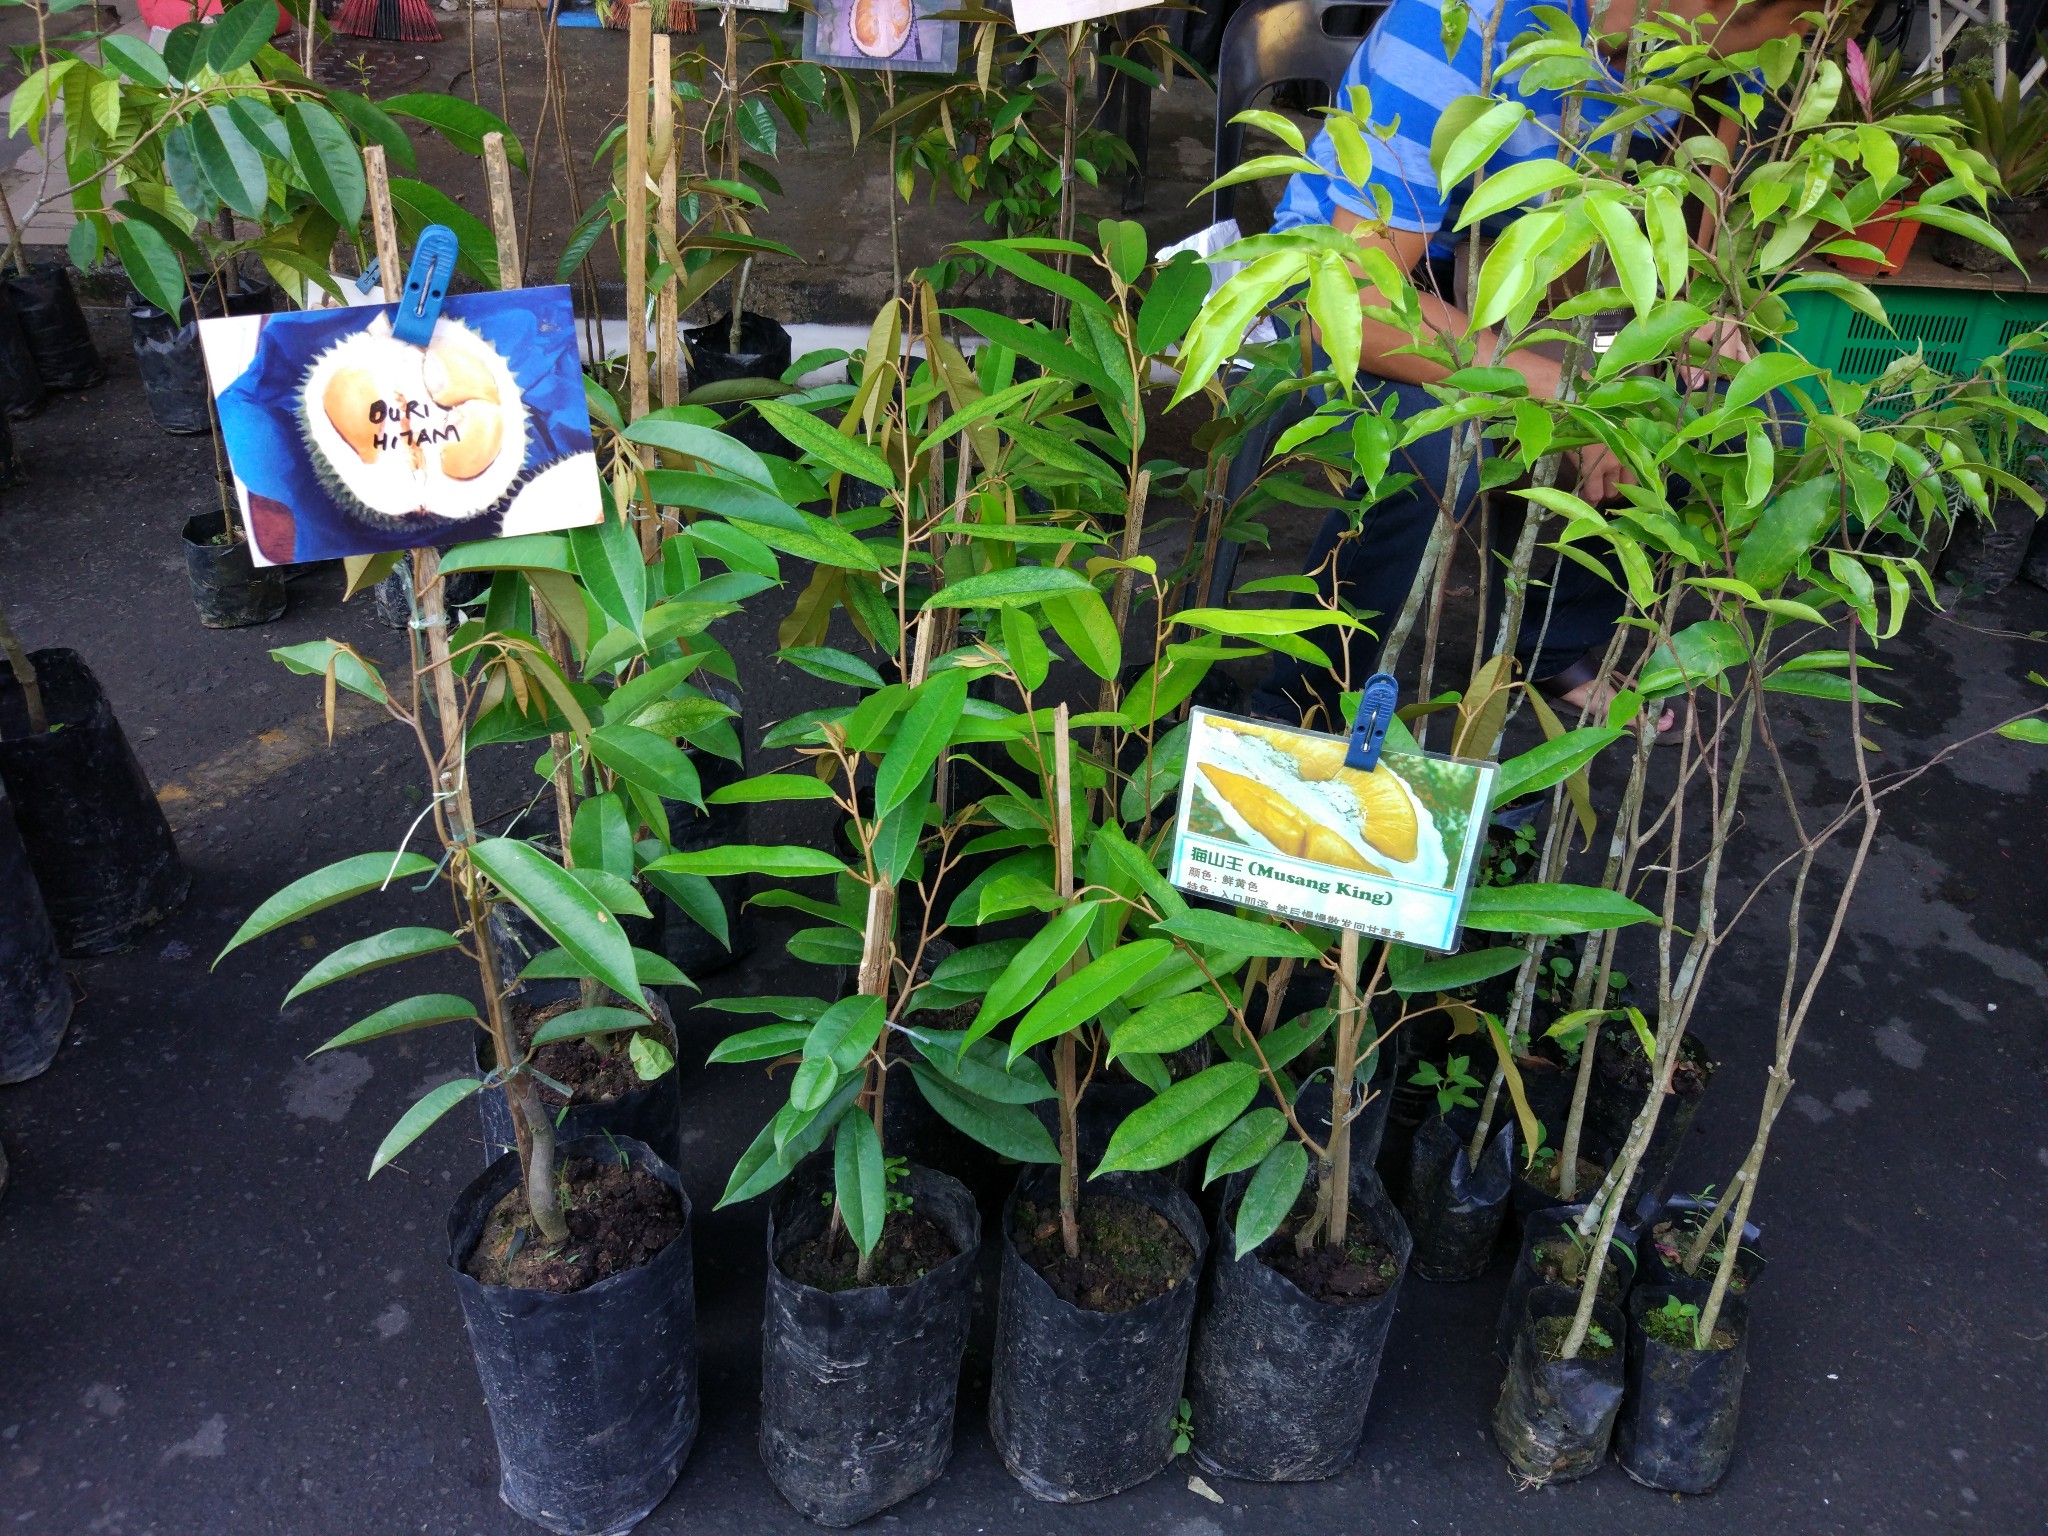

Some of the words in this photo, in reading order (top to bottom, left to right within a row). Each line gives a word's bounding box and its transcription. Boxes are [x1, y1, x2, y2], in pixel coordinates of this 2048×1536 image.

[373, 425, 460, 451] HITAM
[1190, 846, 1244, 872] 猫山王
[1248, 861, 1332, 894] (Musang
[1335, 882, 1393, 906] King)
